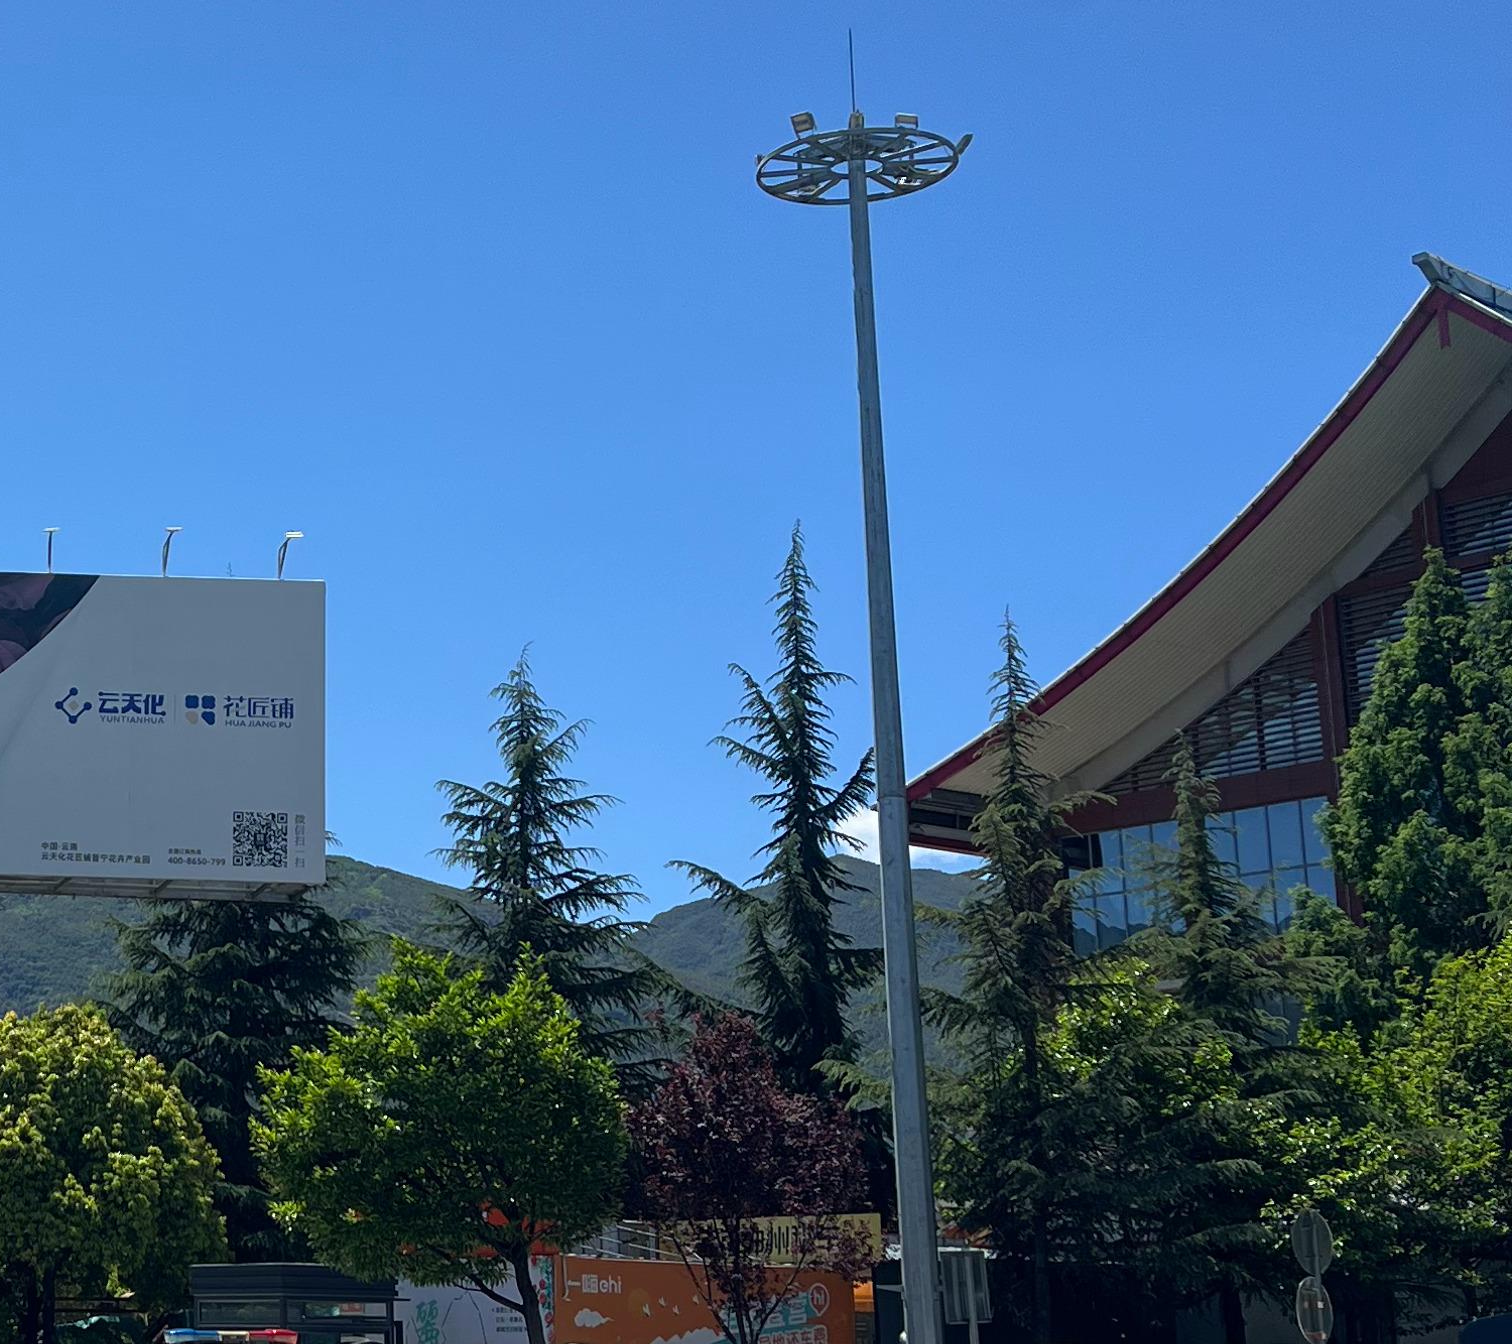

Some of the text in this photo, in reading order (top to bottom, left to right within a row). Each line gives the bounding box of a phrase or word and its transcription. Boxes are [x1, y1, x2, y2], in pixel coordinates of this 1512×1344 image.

[98, 691, 167, 716] 云天化
[223, 695, 295, 719] 花匠铺
[100, 714, 166, 725] YUNTIANHUA
